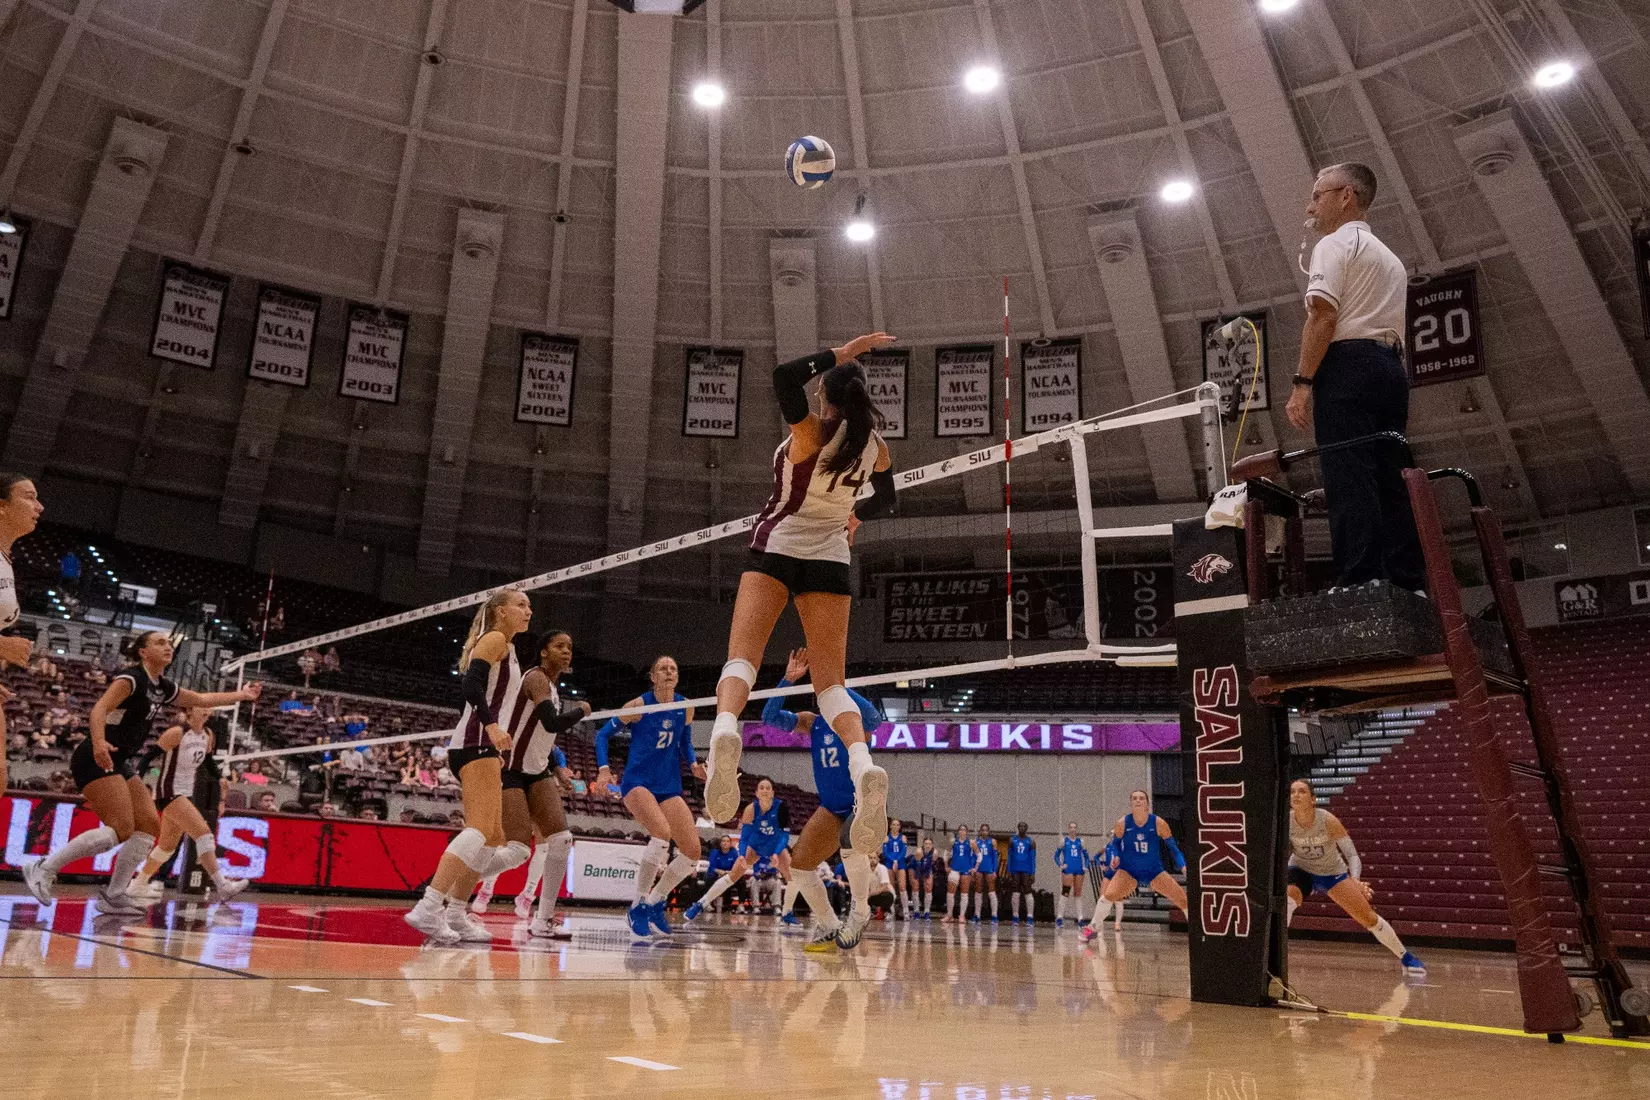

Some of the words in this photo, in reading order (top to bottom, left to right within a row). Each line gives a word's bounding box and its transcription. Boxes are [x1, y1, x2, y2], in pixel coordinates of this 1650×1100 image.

[1416, 289, 1463, 307] VAUGHN
[174, 301, 207, 320] MVC
[161, 314, 215, 333] CHAMPIONS
[262, 320, 305, 342] NCAA
[1413, 307, 1471, 352] 20
[157, 339, 209, 359] 2004
[359, 341, 389, 358] MVC
[254, 360, 304, 378] 2003
[347, 354, 398, 369] CHAMPIONS
[1415, 354, 1476, 375] 1958-1962
[528, 367, 566, 383] NCAA
[1031, 374, 1072, 389] NCAA
[346, 379, 393, 395] 2003
[532, 383, 559, 392] SWEET
[699, 382, 727, 395] MVC
[868, 384, 899, 397] CAA
[949, 380, 979, 393] MVC
[1028, 388, 1076, 399] TOURNAMENT
[527, 391, 563, 402] SIXTEEN
[688, 395, 735, 405] CHAMPIONS
[941, 395, 987, 403] TOURNAMENT
[521, 404, 566, 417] 2002
[940, 404, 988, 413] CHAMPIONS
[688, 418, 733, 430] 2002
[943, 417, 984, 429] 1995
[1031, 412, 1073, 425] 1994
[968, 450, 991, 466] SIU
[826, 458, 865, 498] 14
[903, 469, 925, 484] SIU
[697, 529, 711, 541] SIU
[655, 541, 669, 552] SIU
[616, 552, 630, 563] SIU
[580, 563, 592, 573] SIU
[546, 572, 558, 581] SIU
[891, 579, 991, 597] SALUKIS
[1132, 569, 1158, 637] 2002
[890, 605, 969, 622] SWEET
[890, 622, 988, 640] SIXTEEN
[656, 731, 674, 749] 21
[870, 723, 1093, 750] ALUKIS
[820, 747, 840, 768] 12
[1193, 664, 1250, 938] SALUKIS
[1134, 841, 1149, 854] 19
[583, 864, 636, 880] Banterra
